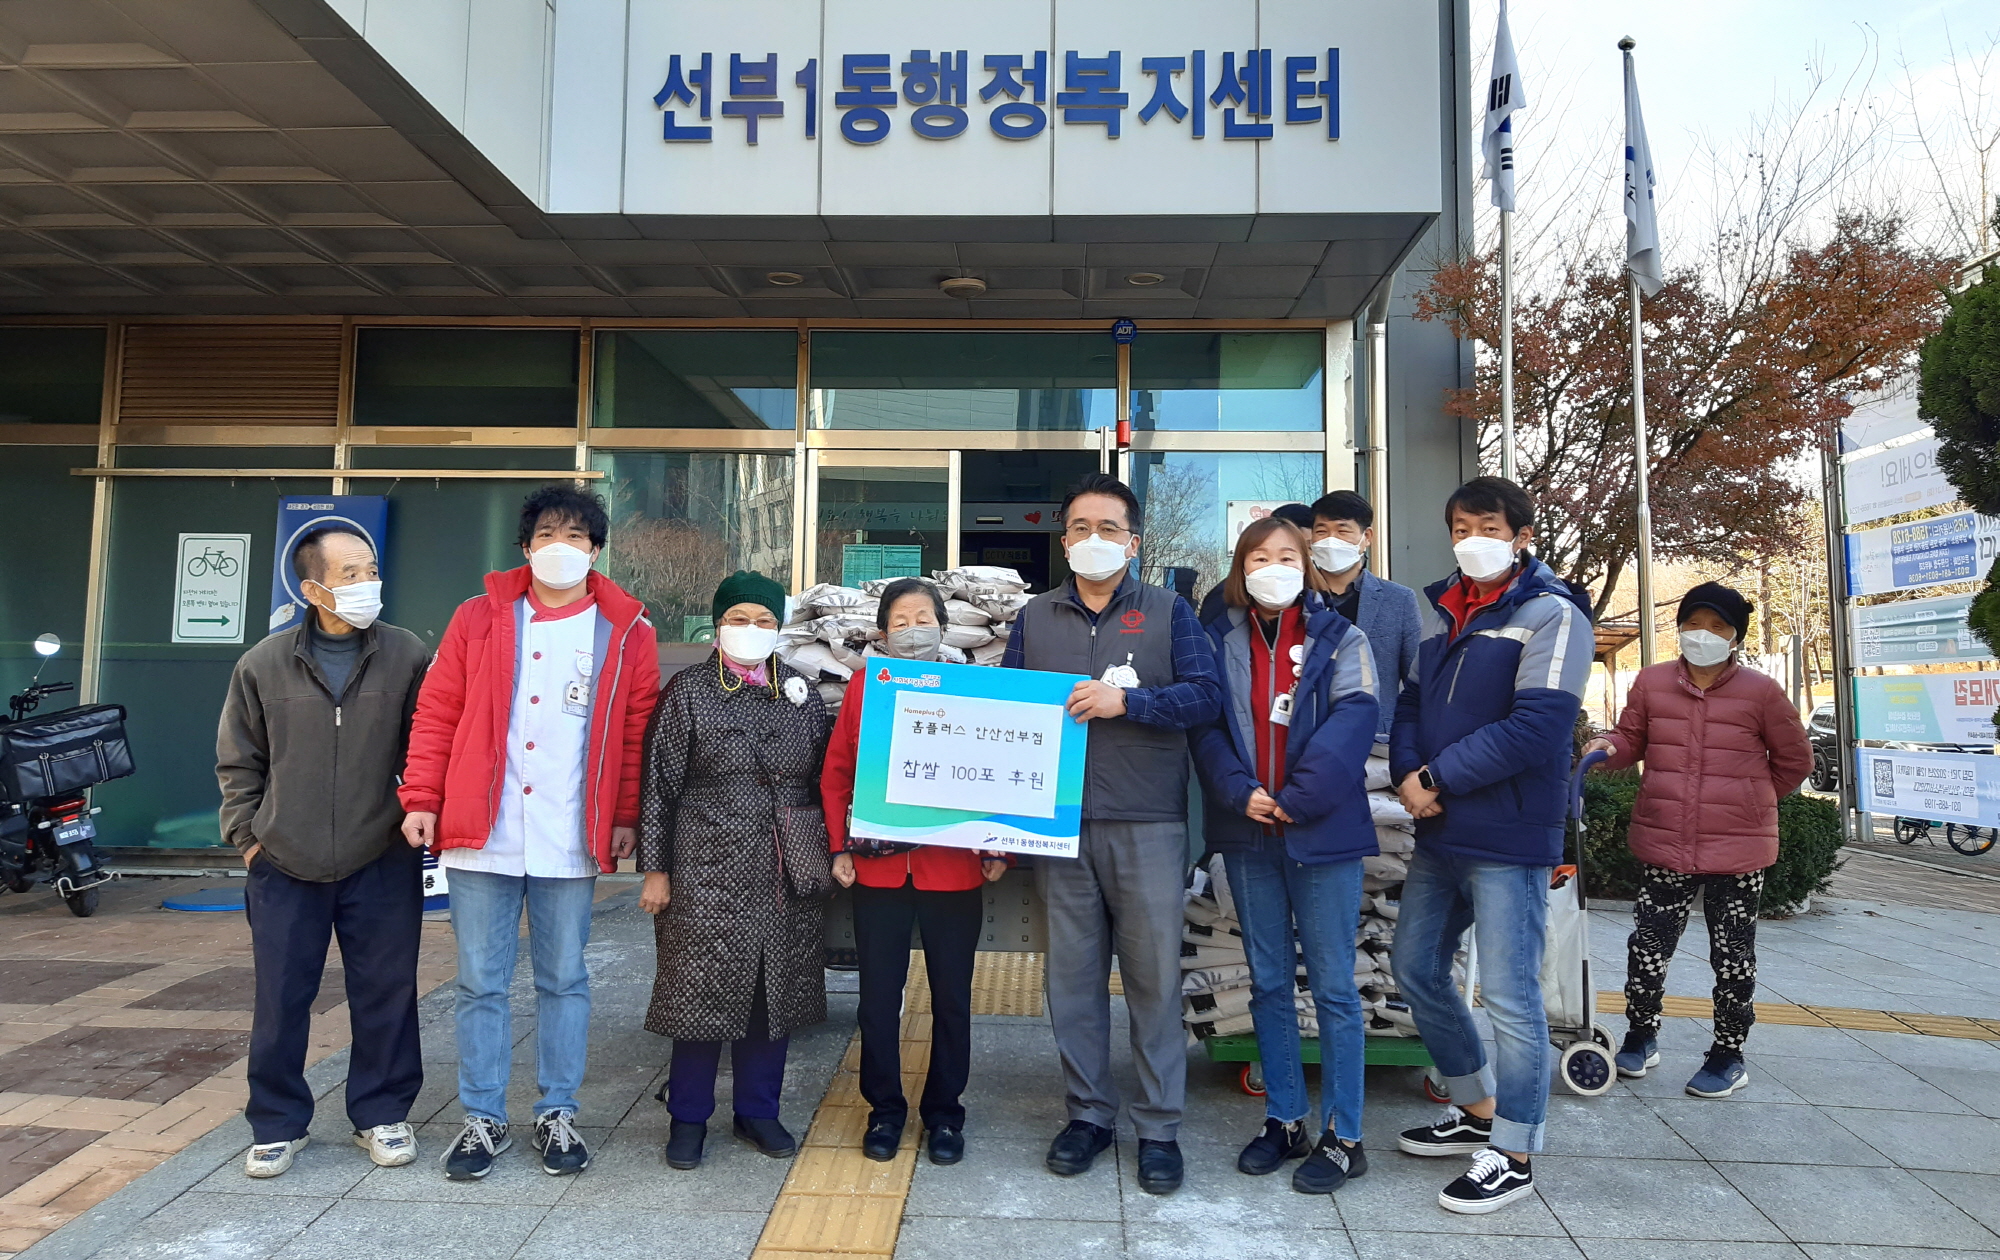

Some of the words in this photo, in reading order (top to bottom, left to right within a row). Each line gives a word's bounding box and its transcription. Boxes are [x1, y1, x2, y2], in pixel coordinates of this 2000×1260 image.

[654, 48, 1341, 145] 선부1동행정복지센터
[1116, 326, 1133, 334] ADT
[904, 707, 935, 716] Homeplus
[912, 720, 966, 736] 홈플러스
[975, 726, 1044, 746] 안산선부점
[902, 759, 940, 781] 찹쌀
[951, 764, 996, 782] 100포
[1008, 768, 1044, 791] 후원
[1001, 835, 1071, 851] 선부1동행정복지센터
